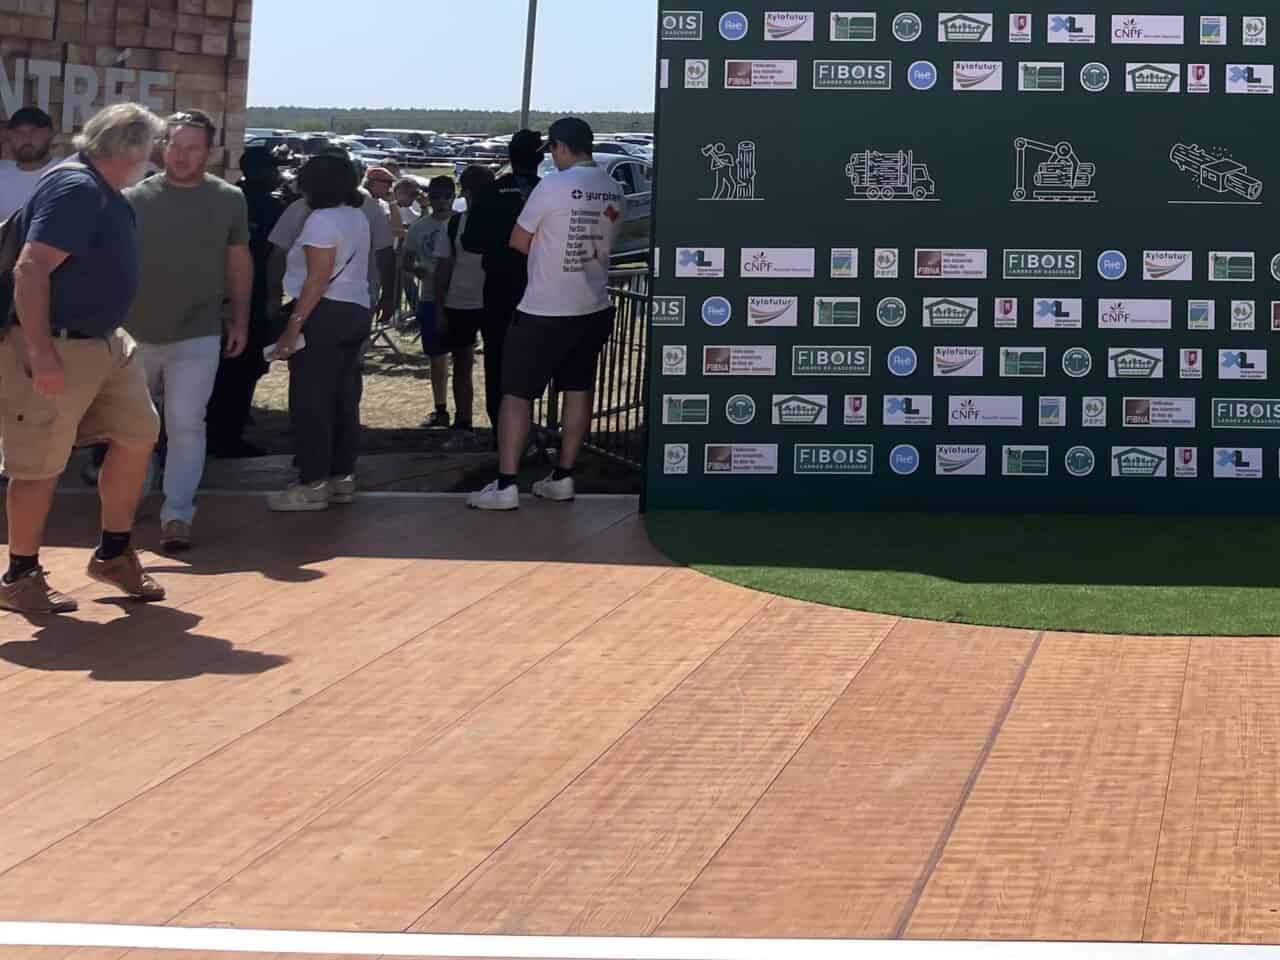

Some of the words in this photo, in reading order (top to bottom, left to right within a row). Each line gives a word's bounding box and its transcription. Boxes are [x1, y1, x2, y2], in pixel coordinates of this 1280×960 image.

[766, 13, 808, 21] Xylofutur
[1114, 29, 1143, 38] CNPF
[955, 63, 997, 71] Xylofutur
[819, 65, 886, 79] FIBOIS
[1145, 252, 1186, 260] Xylofutur
[1009, 254, 1075, 268] FIBOIS
[743, 262, 773, 271] CNPF
[750, 298, 792, 306] Xylofutur
[1101, 313, 1130, 322] CNPF
[936, 348, 977, 356] Xylofutur
[798, 351, 865, 365] FIBOIS
[951, 410, 980, 419] CNPF
[800, 449, 867, 463] FIBOIS
